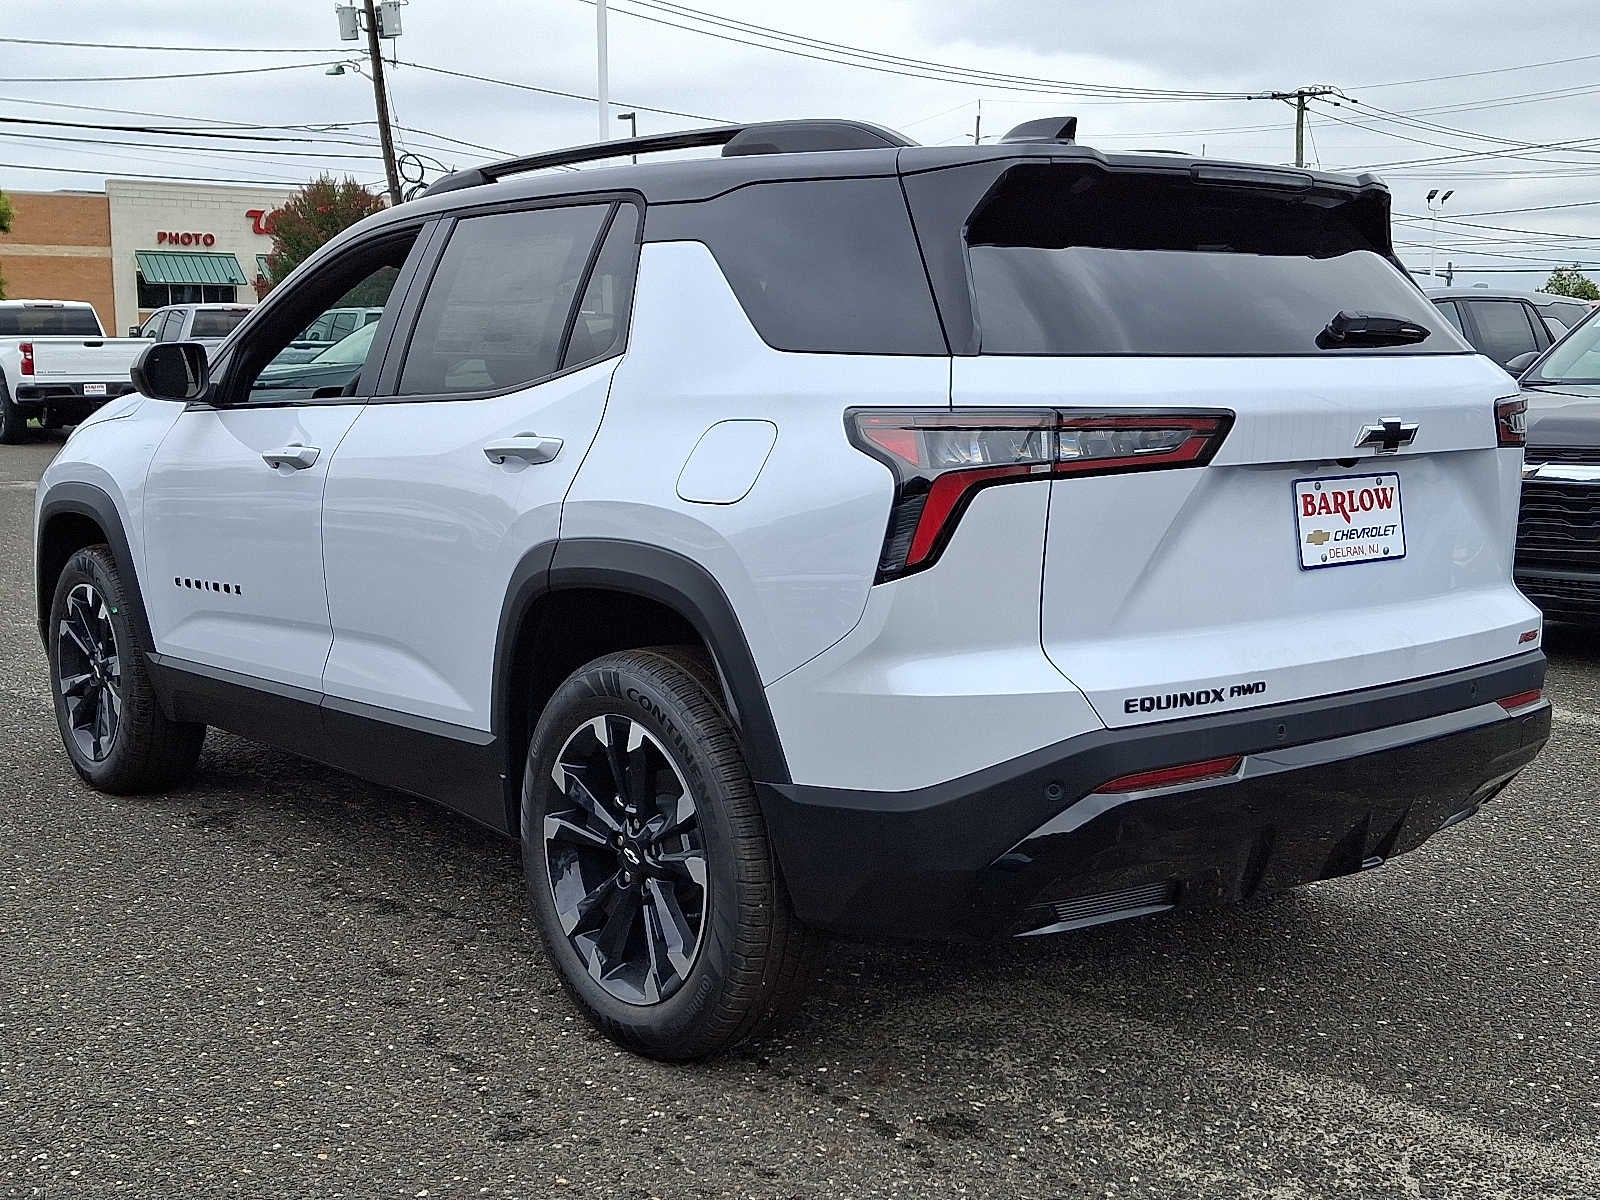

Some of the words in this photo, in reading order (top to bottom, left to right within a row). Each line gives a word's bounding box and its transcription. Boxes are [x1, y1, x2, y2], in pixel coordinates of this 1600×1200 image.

[157, 231, 216, 247] PHOTO
[1301, 487, 1395, 524] BARLOW
[1333, 524, 1398, 542] CHEVROLET
[1329, 545, 1367, 559] DELRAN,
[1368, 543, 1379, 554] NJ
[1124, 687, 1225, 714] EQUINOX
[1229, 681, 1267, 698] AWD
